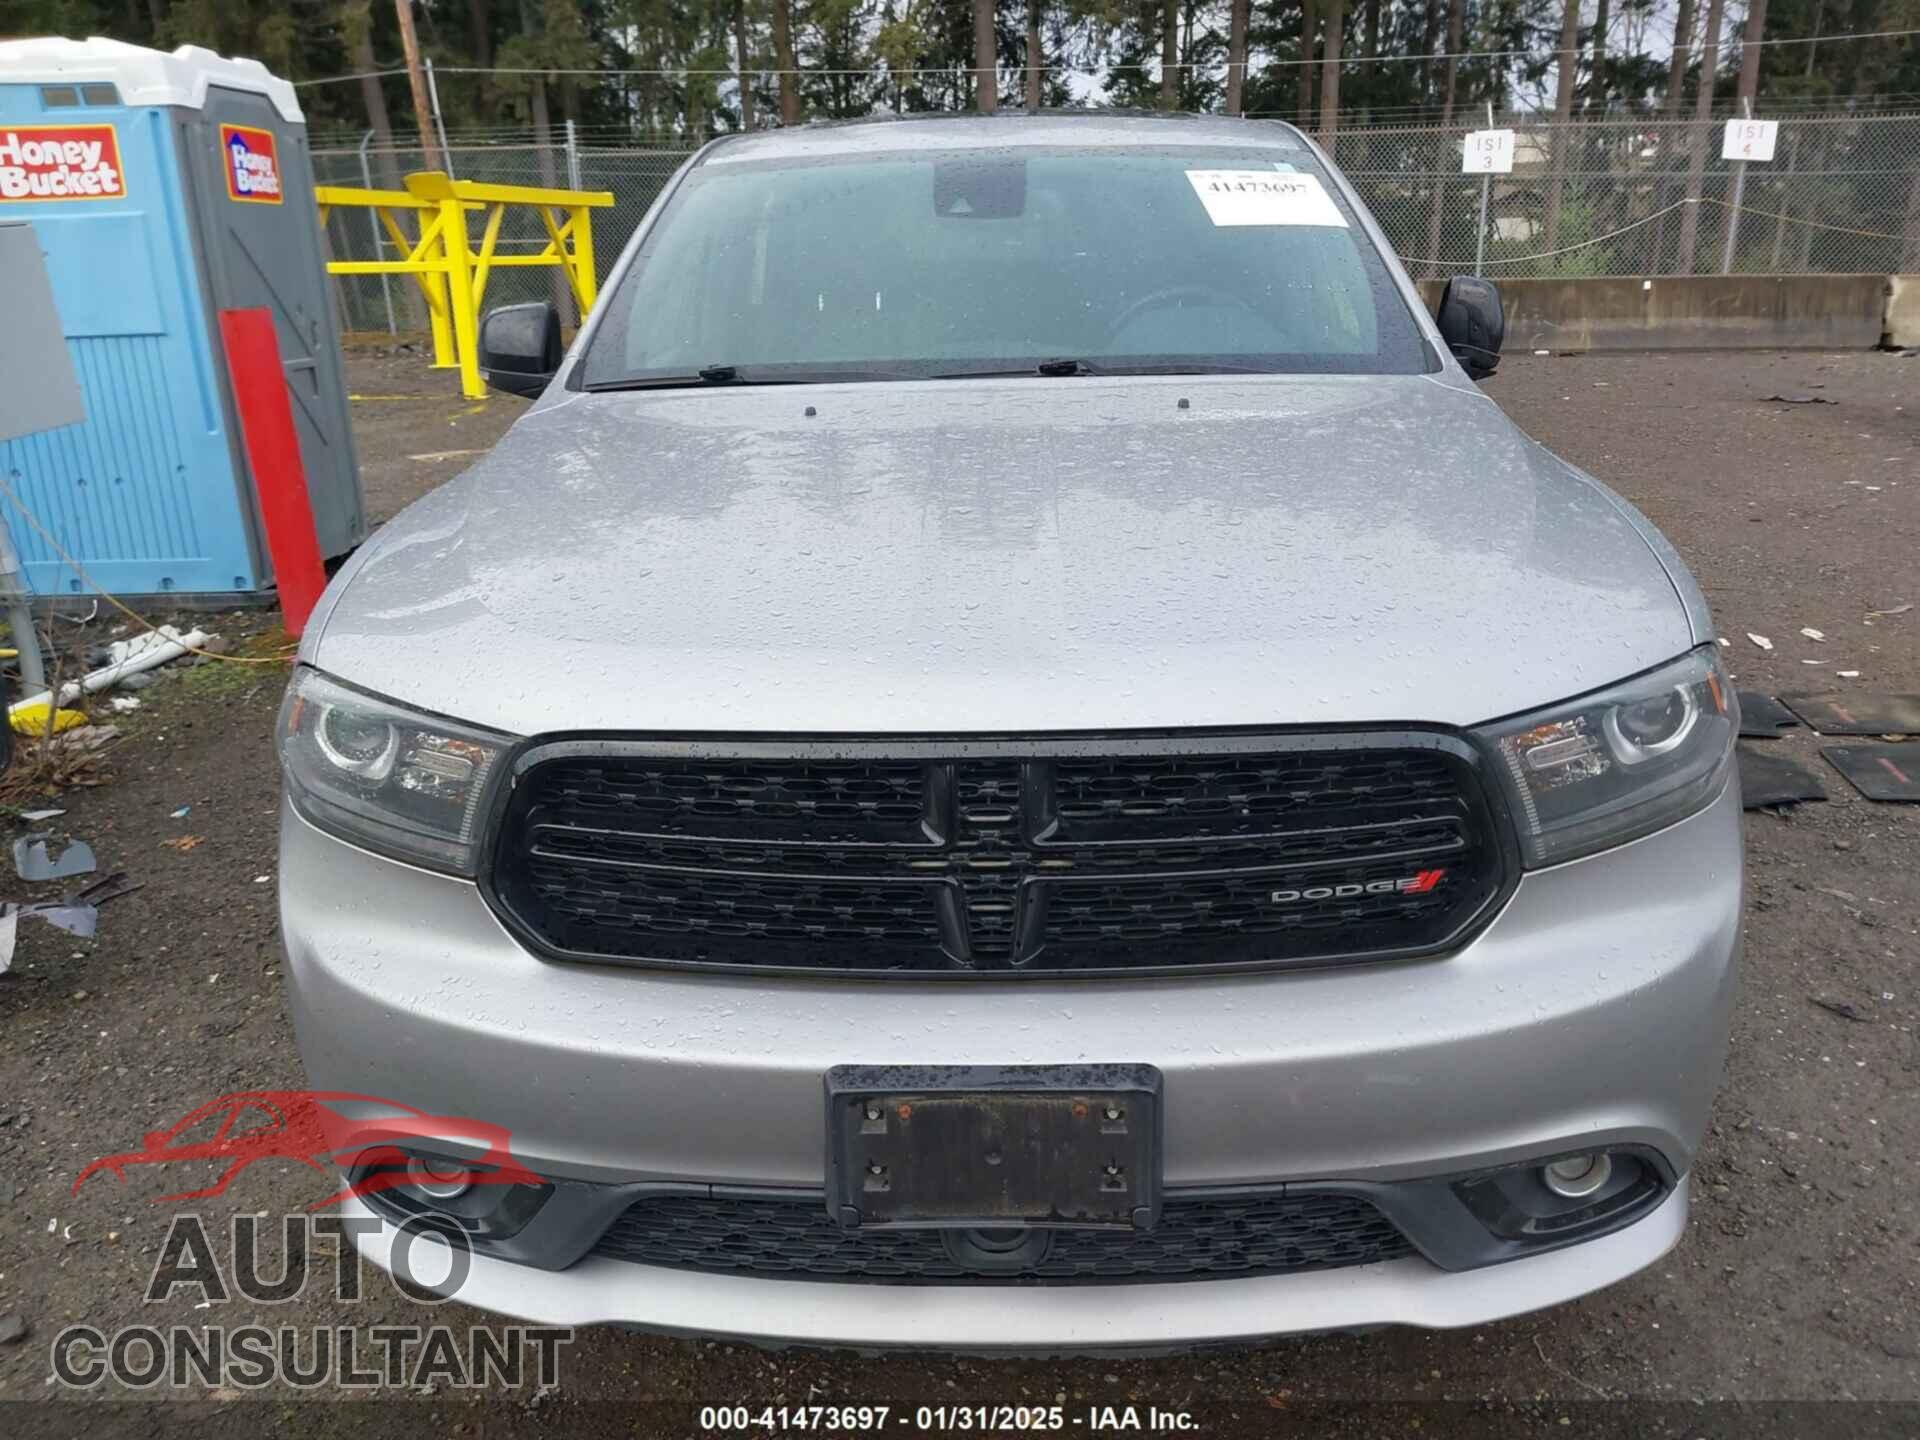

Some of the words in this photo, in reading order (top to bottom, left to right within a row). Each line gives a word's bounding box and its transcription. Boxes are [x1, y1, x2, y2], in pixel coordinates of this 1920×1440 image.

[0, 132, 103, 171] Honey
[1483, 155, 1493, 168] 3
[0, 161, 120, 197] Bucket
[1272, 877, 1423, 902] DODGE
